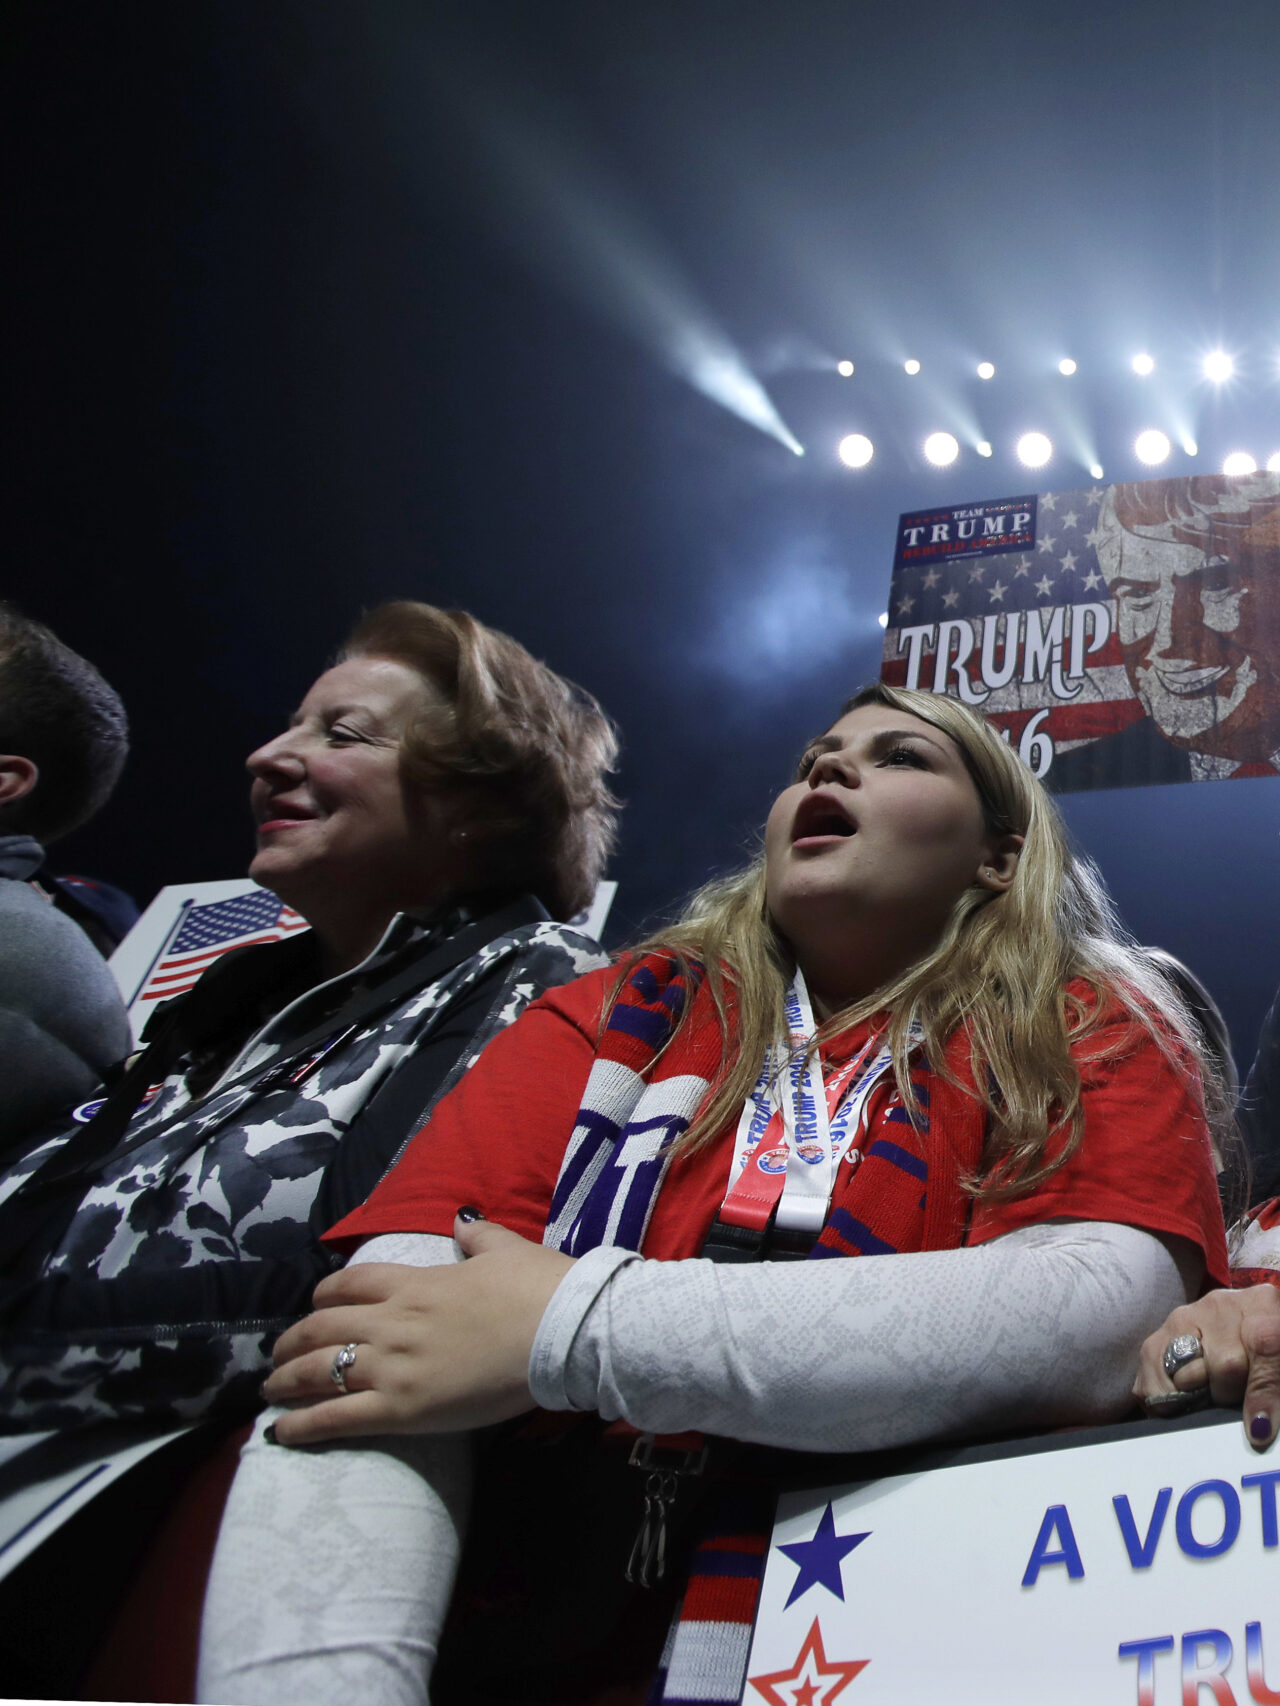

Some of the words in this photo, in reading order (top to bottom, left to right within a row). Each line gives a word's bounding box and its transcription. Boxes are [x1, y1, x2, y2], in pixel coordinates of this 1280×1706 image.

[903, 512, 1031, 547] TRUMP
[952, 507, 984, 520] TEAM
[899, 602, 1111, 706] TRUMP
[792, 1091, 818, 1144] TRUMP
[829, 1097, 858, 1142] 2016
[1021, 1504, 1085, 1588] A
